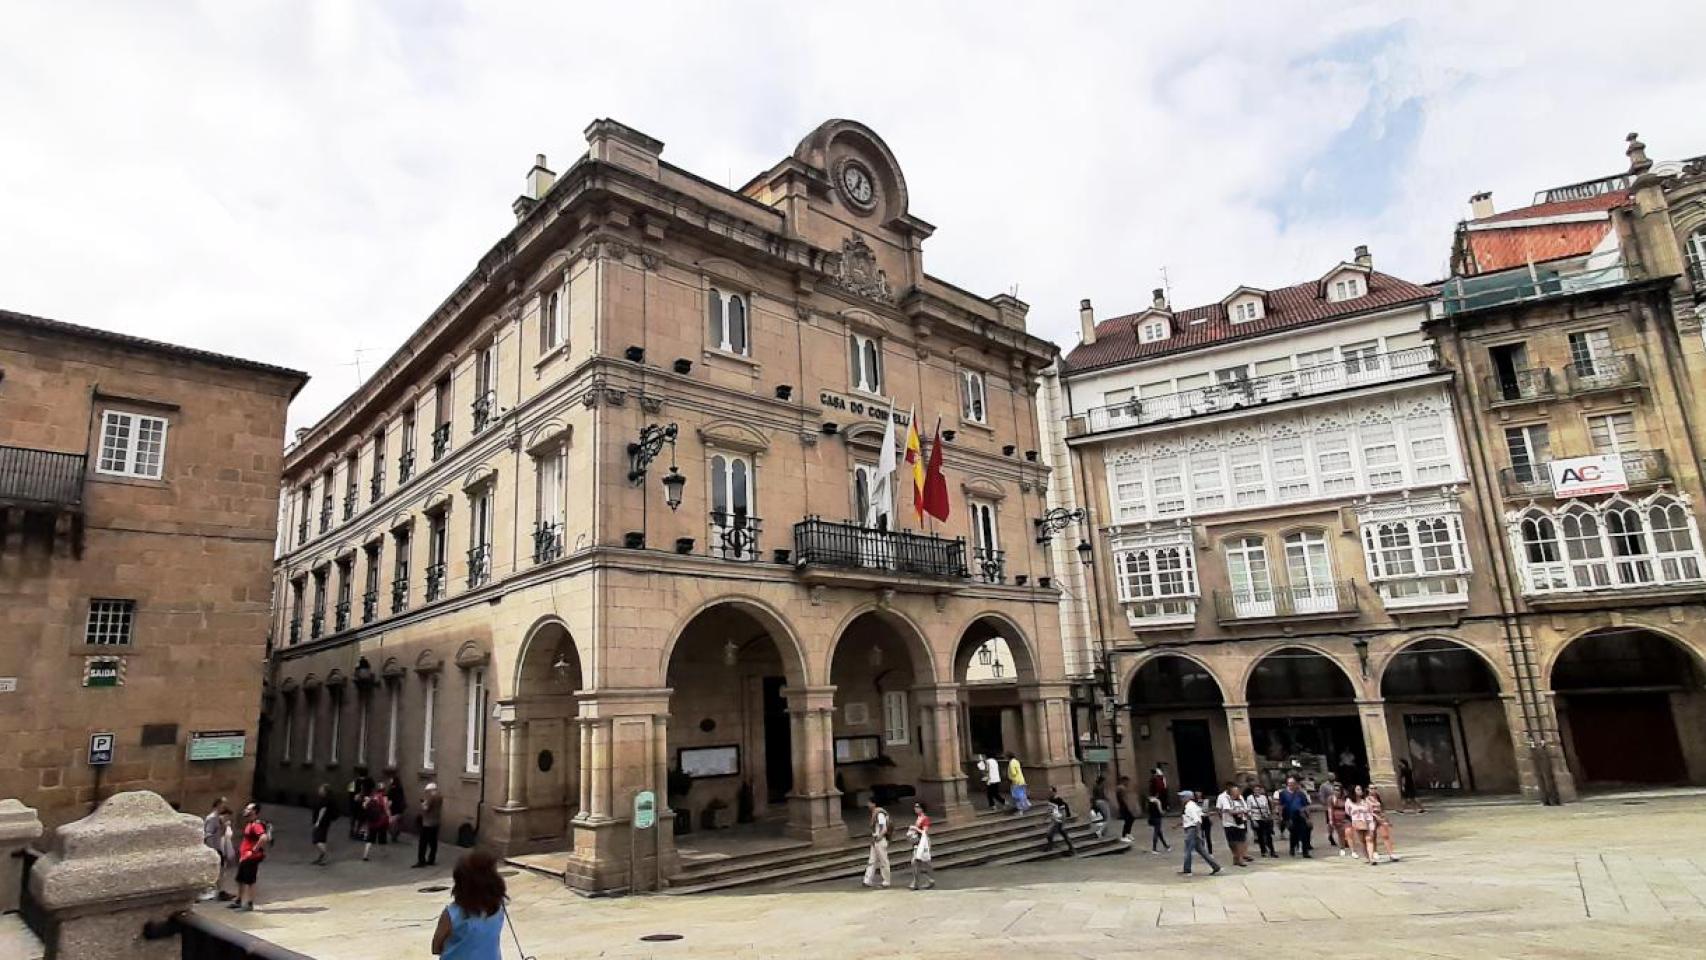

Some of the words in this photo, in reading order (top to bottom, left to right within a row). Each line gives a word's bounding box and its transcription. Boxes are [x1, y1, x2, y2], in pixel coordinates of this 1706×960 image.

[820, 393, 846, 410] CASA
[851, 402, 863, 414] DO
[868, 407, 910, 426] CONELL
[97, 738, 107, 749] P
